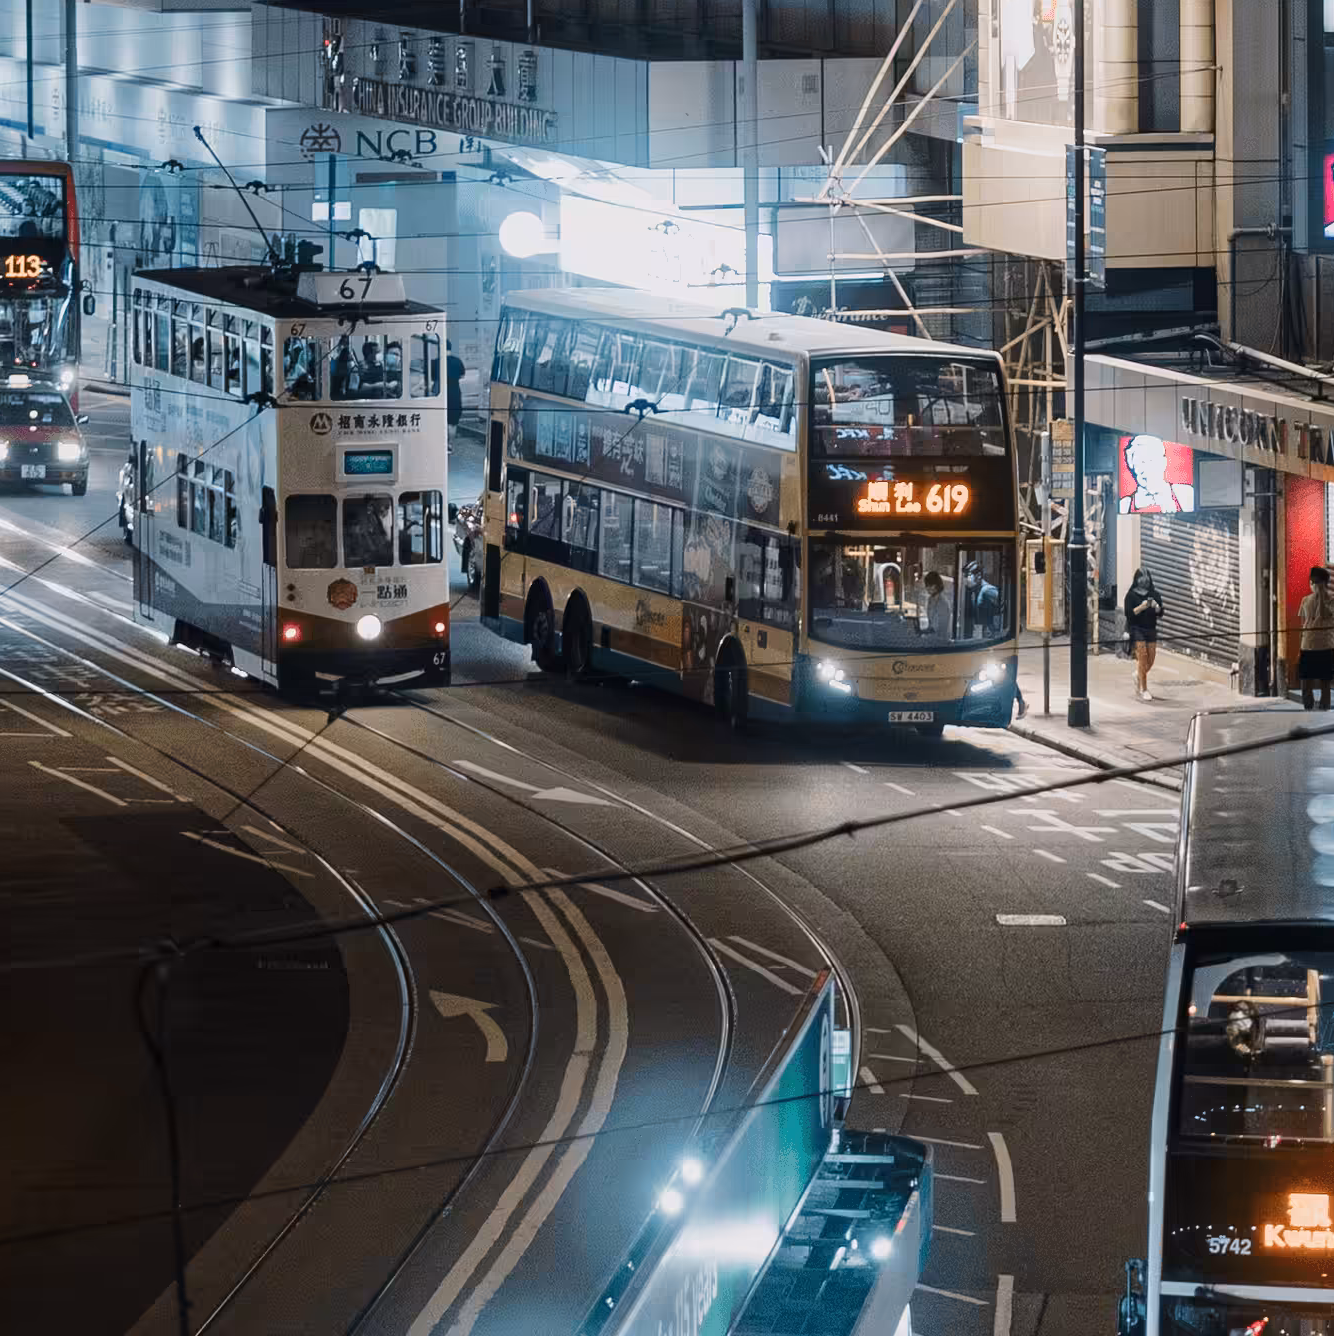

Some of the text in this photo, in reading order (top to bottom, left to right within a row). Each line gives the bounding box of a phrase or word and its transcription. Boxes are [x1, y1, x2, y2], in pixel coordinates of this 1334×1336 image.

[352, 76, 551, 145] CHINA INSURANCE GROUP BUILDING
[356, 129, 438, 156] NCB
[5, 254, 42, 278] 113
[339, 277, 372, 300] 67
[290, 323, 306, 336] 67
[425, 319, 439, 332] 67
[337, 413, 421, 429] 招商永隆銀行
[1181, 396, 1288, 455] UNICORN
[858, 498, 891, 513] Shun
[925, 484, 970, 513] 619
[433, 652, 446, 665] 67
[1208, 1236, 1252, 1255] 5742
